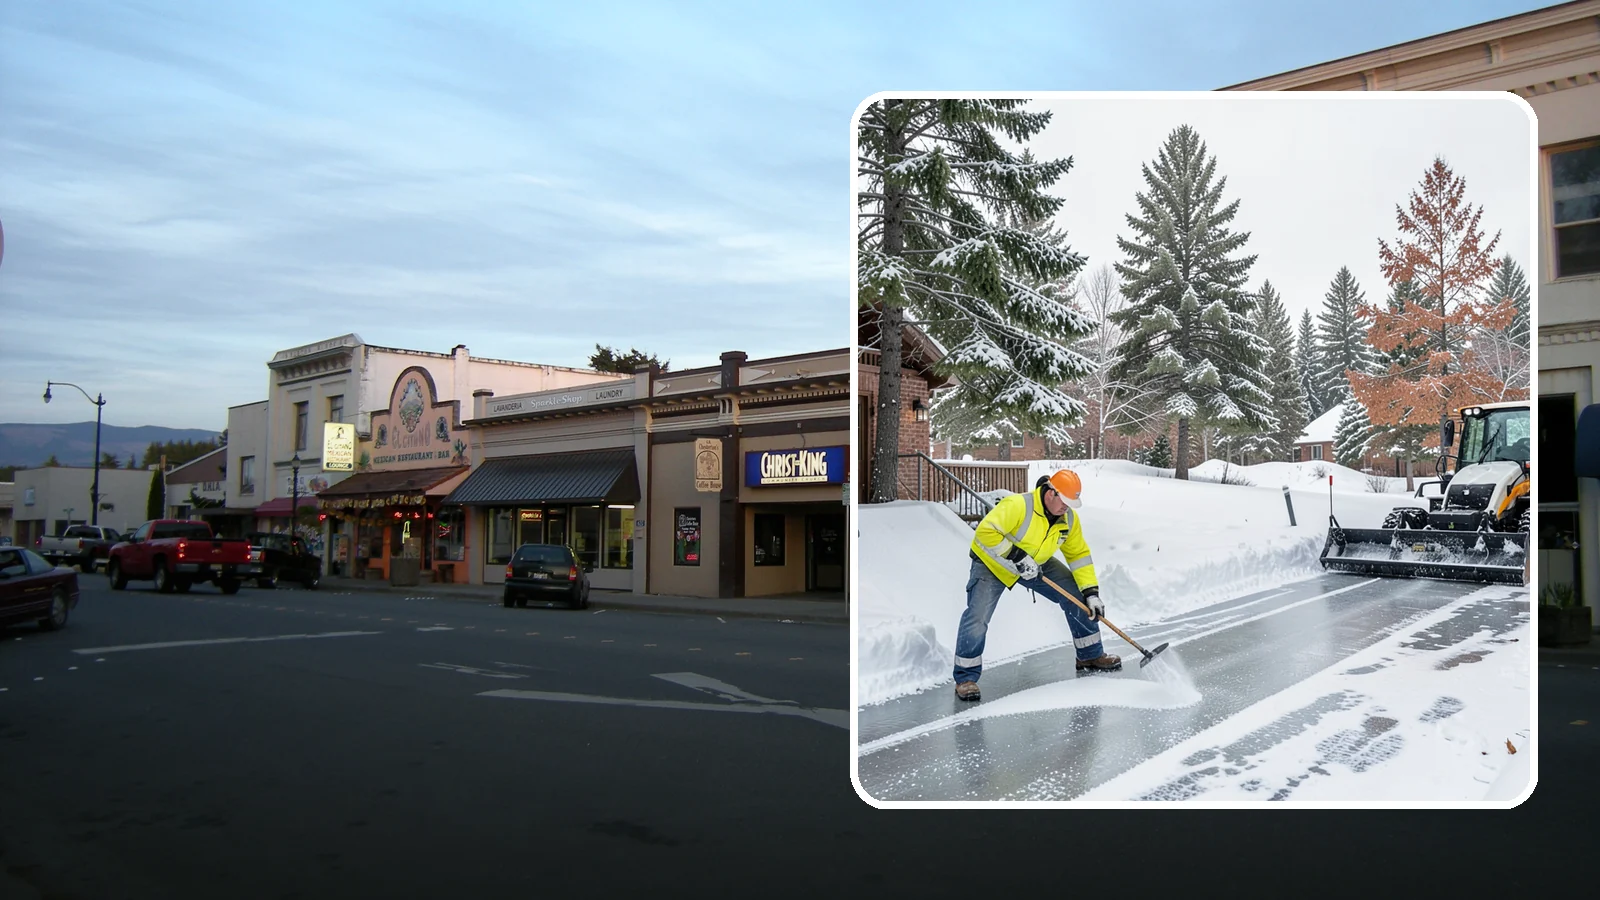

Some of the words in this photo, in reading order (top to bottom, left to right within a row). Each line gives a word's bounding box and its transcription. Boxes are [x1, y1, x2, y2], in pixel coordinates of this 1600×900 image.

[595, 389, 624, 400] LAUNDRY
[493, 402, 523, 413] LAVANDERIA
[530, 397, 561, 409] Sparkle
[561, 394, 583, 407] Shop
[373, 455, 396, 464] MEXICAN
[397, 451, 433, 463] RESTAURANT
[438, 450, 450, 459] BAR
[761, 452, 797, 478] CHRIST
[798, 451, 828, 477] KING
[697, 480, 709, 489] Coffee
[710, 480, 722, 489] House
